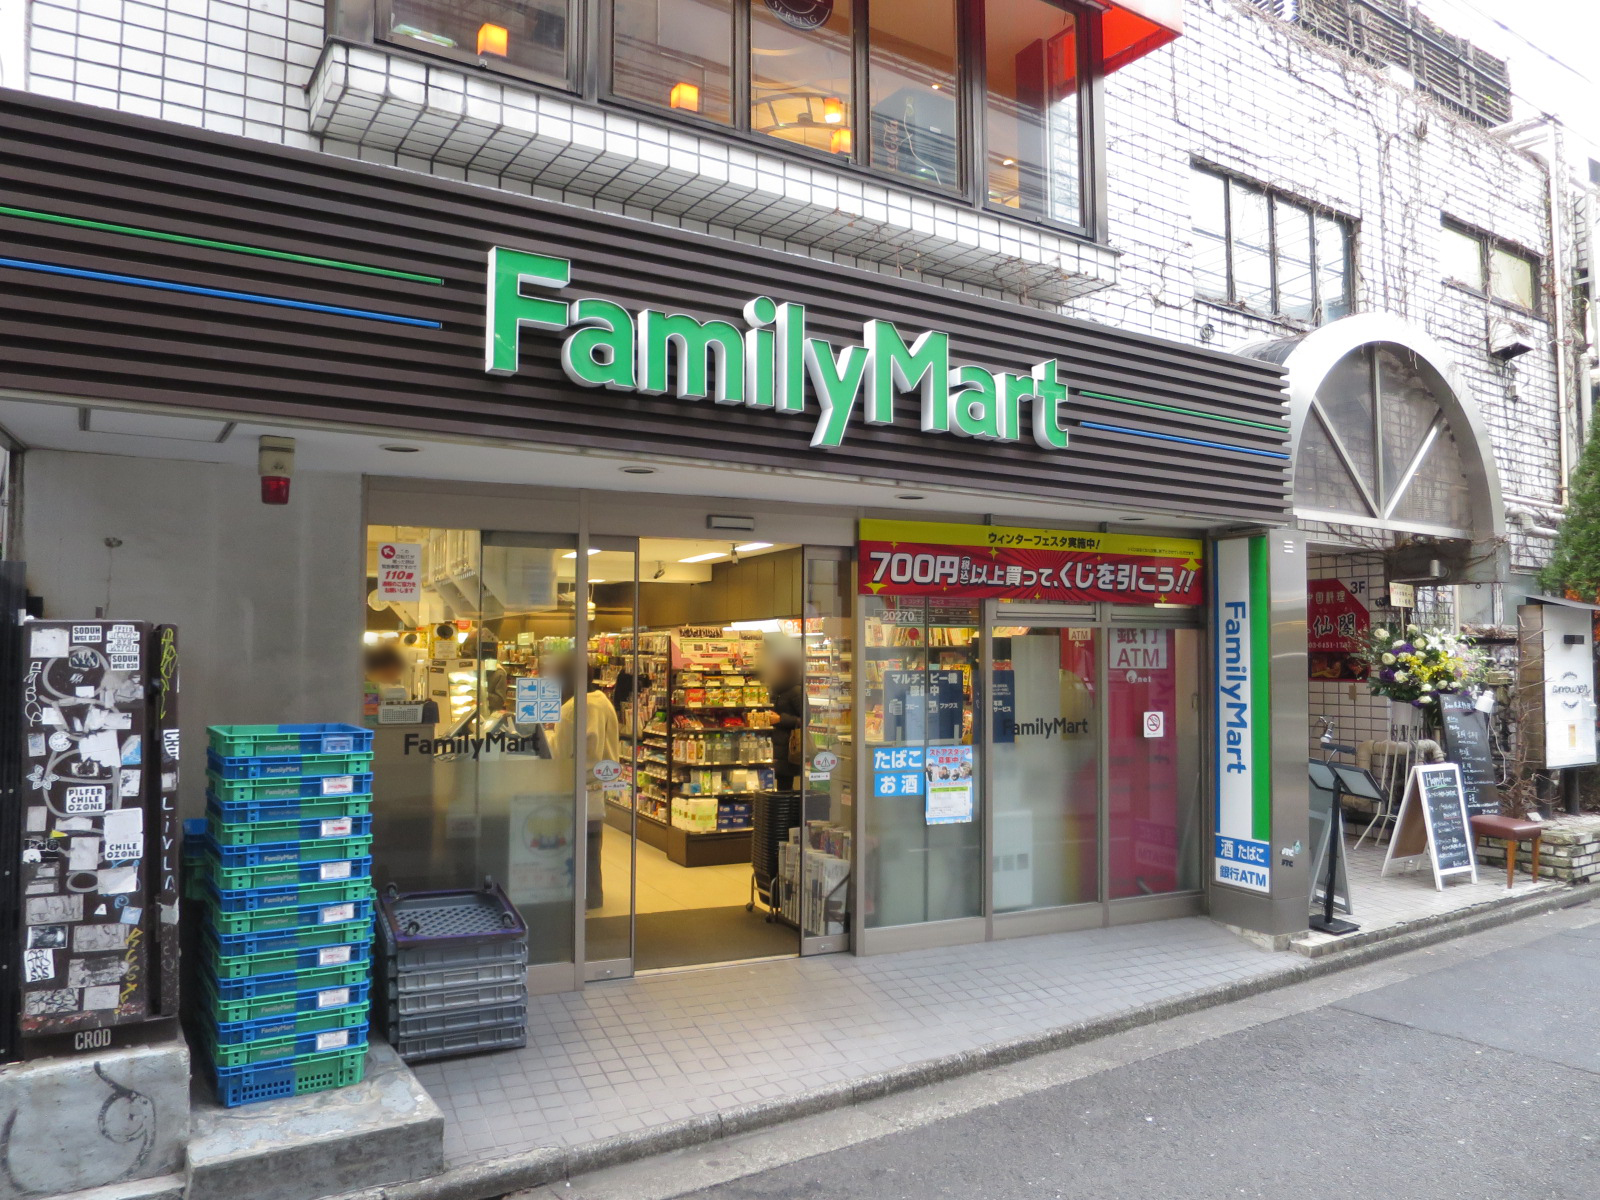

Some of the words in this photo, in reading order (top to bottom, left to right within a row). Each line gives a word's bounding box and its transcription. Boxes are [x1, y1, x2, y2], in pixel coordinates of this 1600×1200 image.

[485, 245, 1069, 450] FamilyMart
[988, 532, 1101, 550] ウィンターフェスタ実施中!
[1350, 581, 1365, 594] 3F
[882, 611, 914, 621] 20270
[73, 626, 101, 634] SODUH
[1072, 630, 1089, 640] ATM
[1117, 648, 1160, 667] ATM
[1220, 601, 1248, 774] FamilyMart
[404, 732, 539, 759] FamilyMart
[875, 750, 922, 769] たばこ
[68, 788, 103, 796] PILFER
[880, 775, 918, 794] お酒
[67, 803, 103, 811] OZONE
[106, 850, 141, 858] OZONE
[1221, 838, 1234, 858] 酒
[1238, 843, 1265, 863] たばこ
[1220, 864, 1267, 887] 銀行ATM
[74, 1029, 112, 1050] CROD
